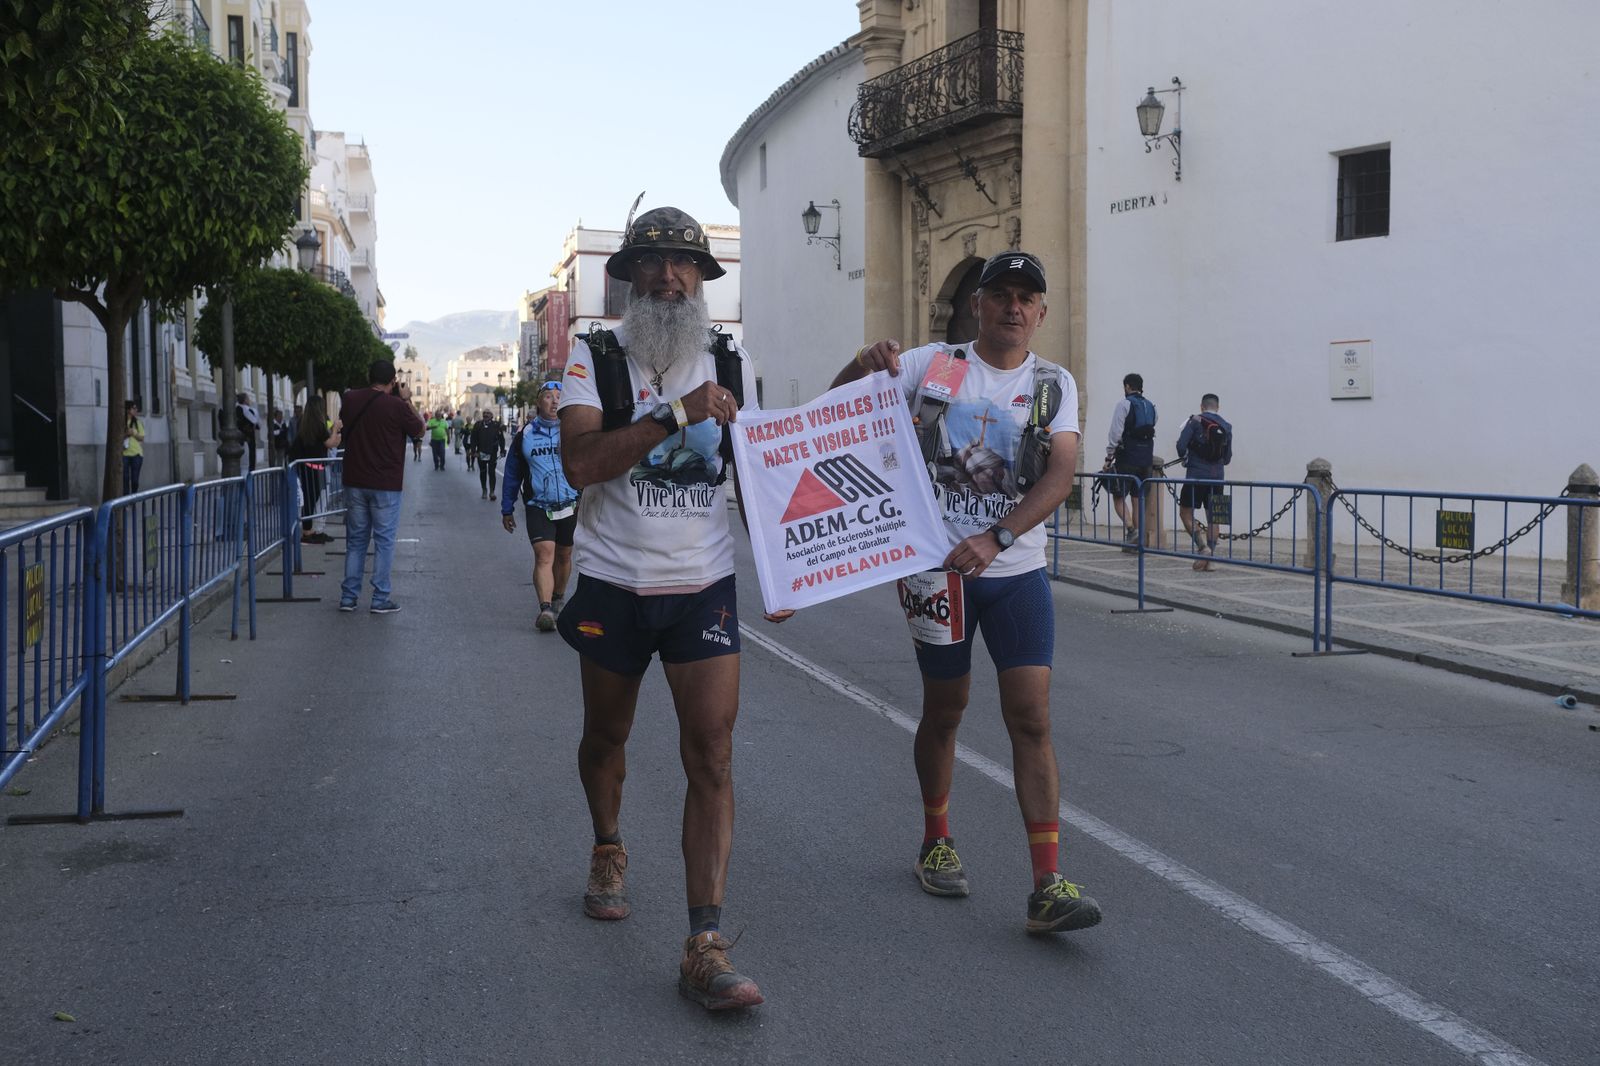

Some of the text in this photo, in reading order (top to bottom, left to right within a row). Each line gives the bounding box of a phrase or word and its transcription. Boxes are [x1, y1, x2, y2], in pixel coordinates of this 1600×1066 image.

[1111, 195, 1156, 214] PUERTA
[745, 414, 804, 445] HAZNOS
[806, 394, 873, 428] VISIBLES
[762, 440, 810, 469] HAZTE
[812, 423, 869, 455] VISIBLE
[635, 481, 716, 508] Vive la vida
[964, 488, 980, 516] la
[660, 509, 669, 518] de
[784, 498, 902, 549] ADEM-C.G.
[951, 515, 961, 524] de
[786, 519, 907, 561] Asociación de Esclerosis Múltiple
[1442, 523, 1470, 536] LOCAL
[806, 535, 890, 567] del Campo de Gibraltar
[791, 544, 916, 592] #VIVELAVIDA
